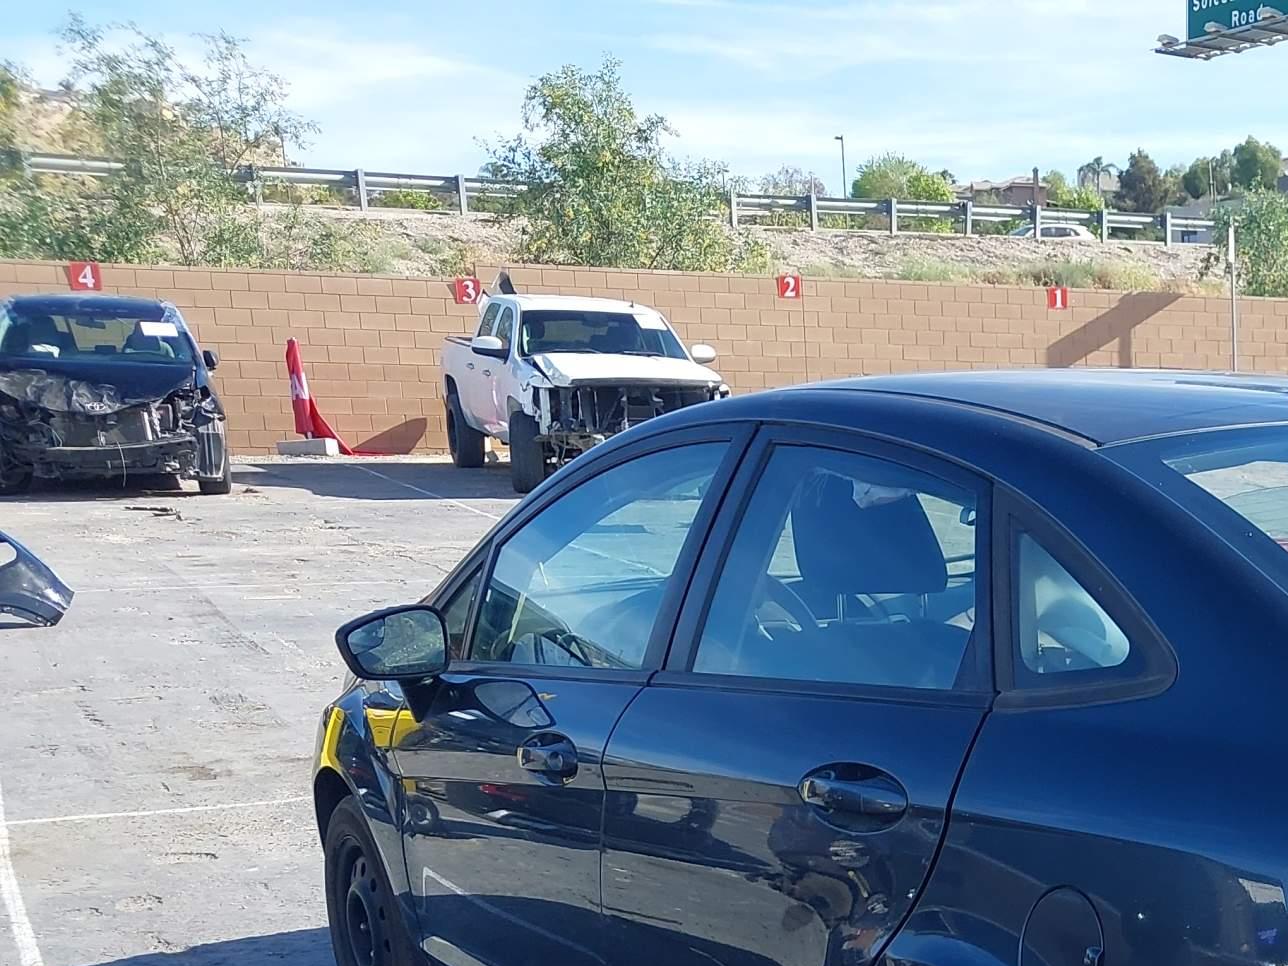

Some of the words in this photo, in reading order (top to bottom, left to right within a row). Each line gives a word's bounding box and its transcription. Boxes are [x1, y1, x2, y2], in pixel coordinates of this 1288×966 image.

[78, 265, 95, 288] 4
[783, 277, 796, 297] 2
[462, 280, 476, 302] 3
[1053, 289, 1065, 308] 1
